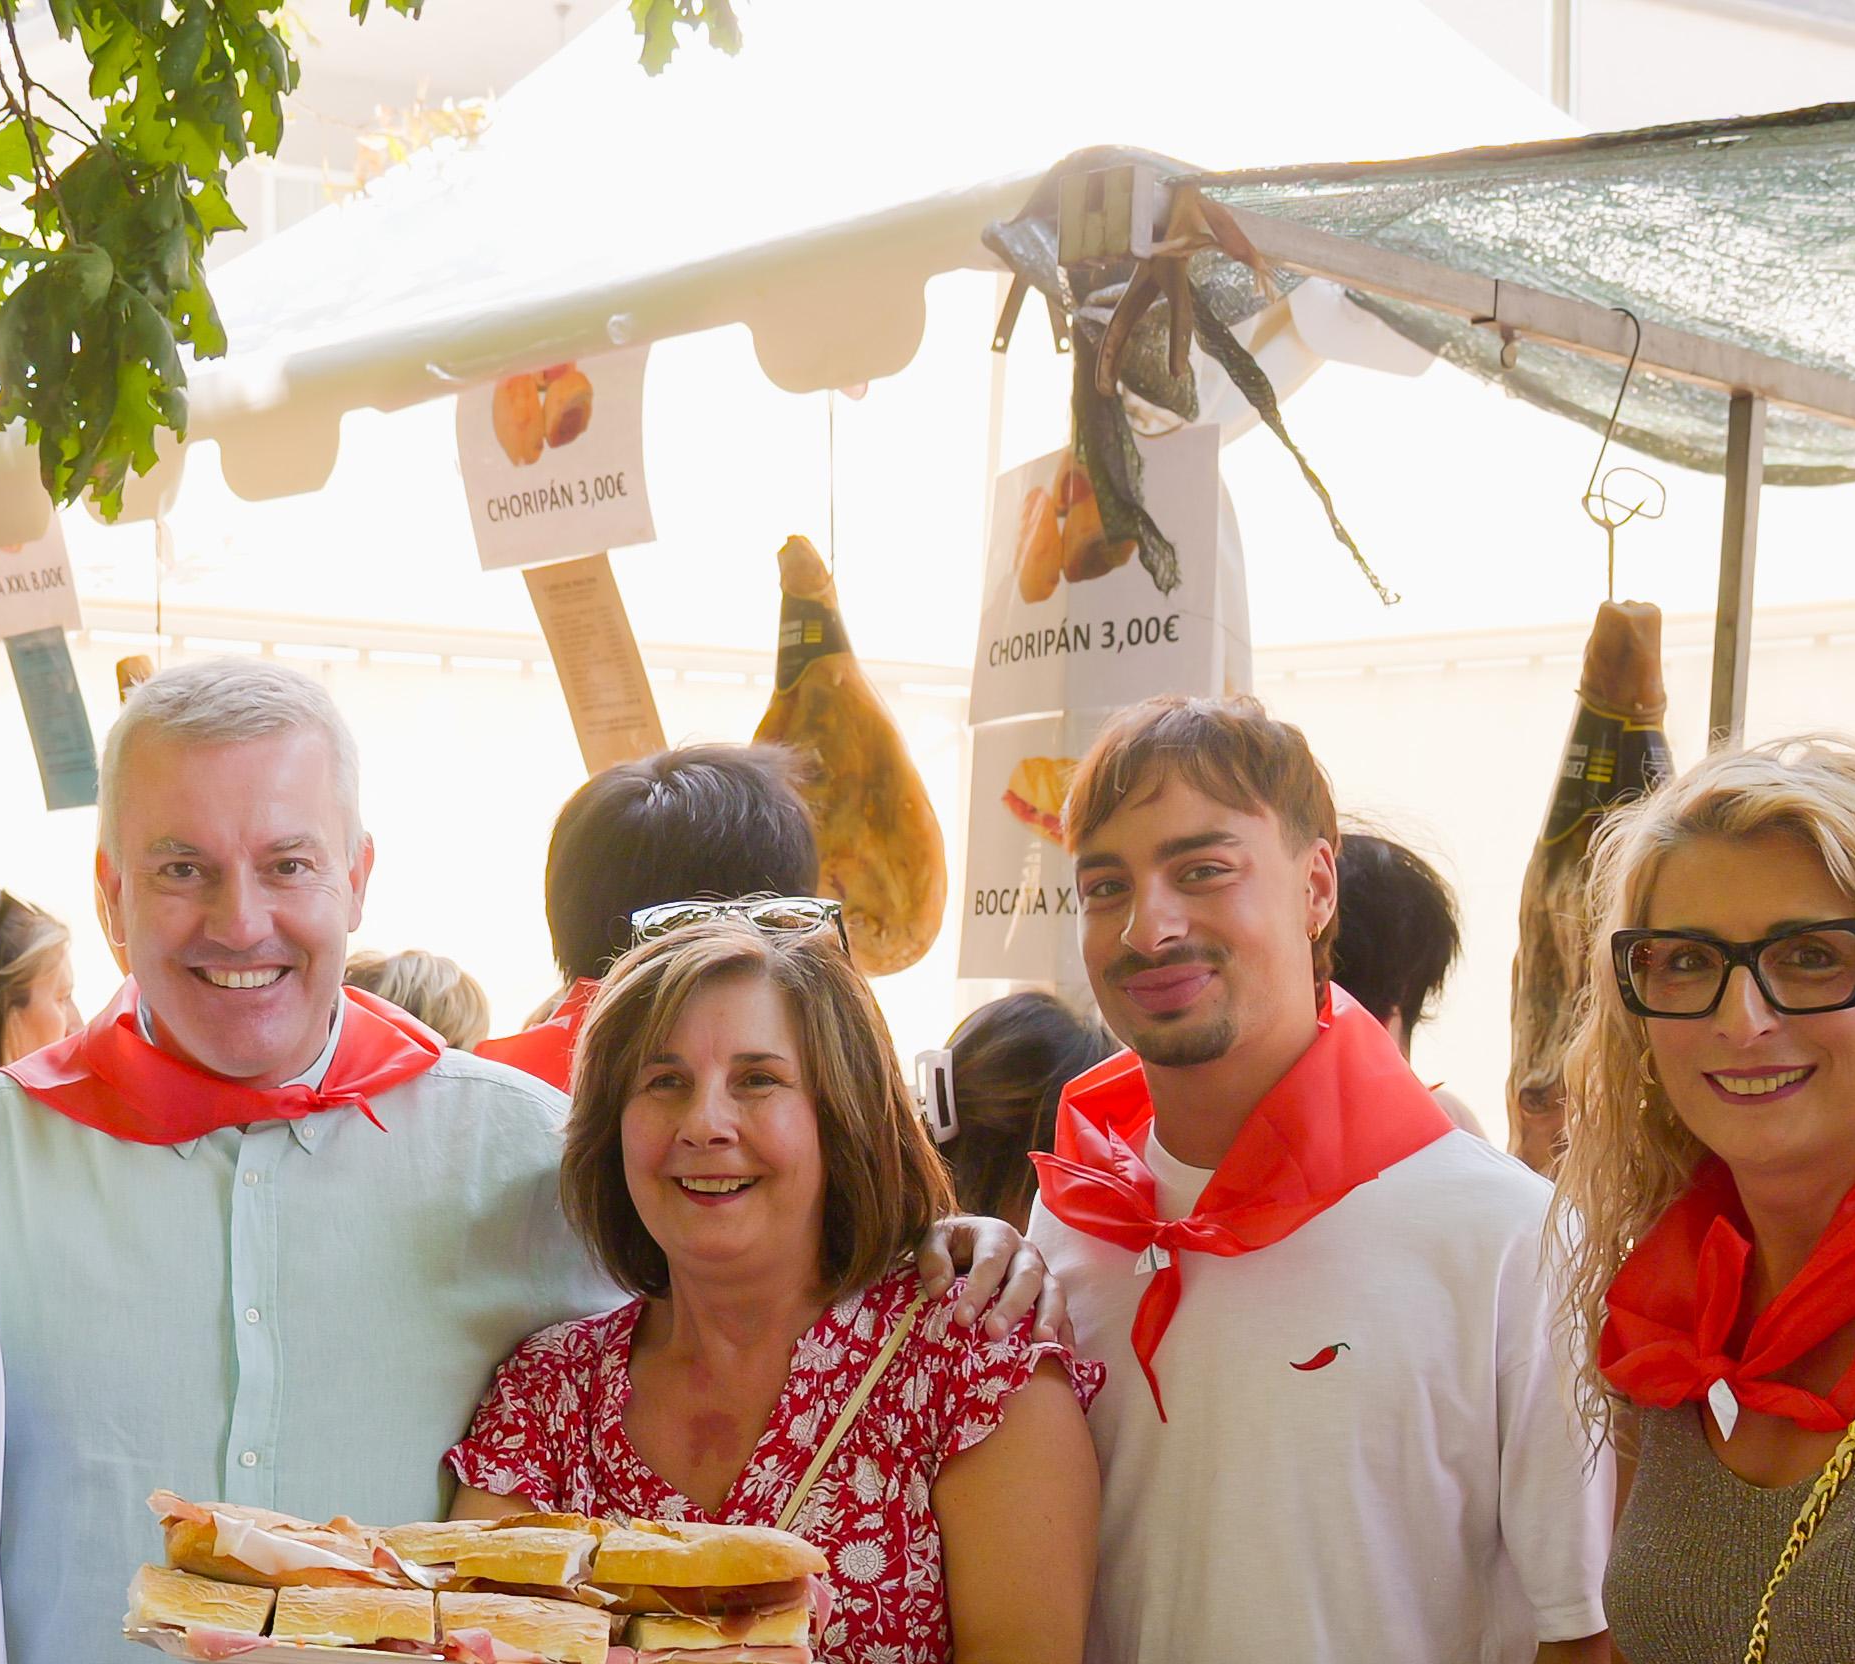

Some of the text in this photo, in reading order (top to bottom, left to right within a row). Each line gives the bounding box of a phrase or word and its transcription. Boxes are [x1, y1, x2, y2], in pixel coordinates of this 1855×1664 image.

[487, 471, 628, 523] CHORIPÁN 3,00€
[989, 614, 1180, 668] CHORIPÁN 3,00€
